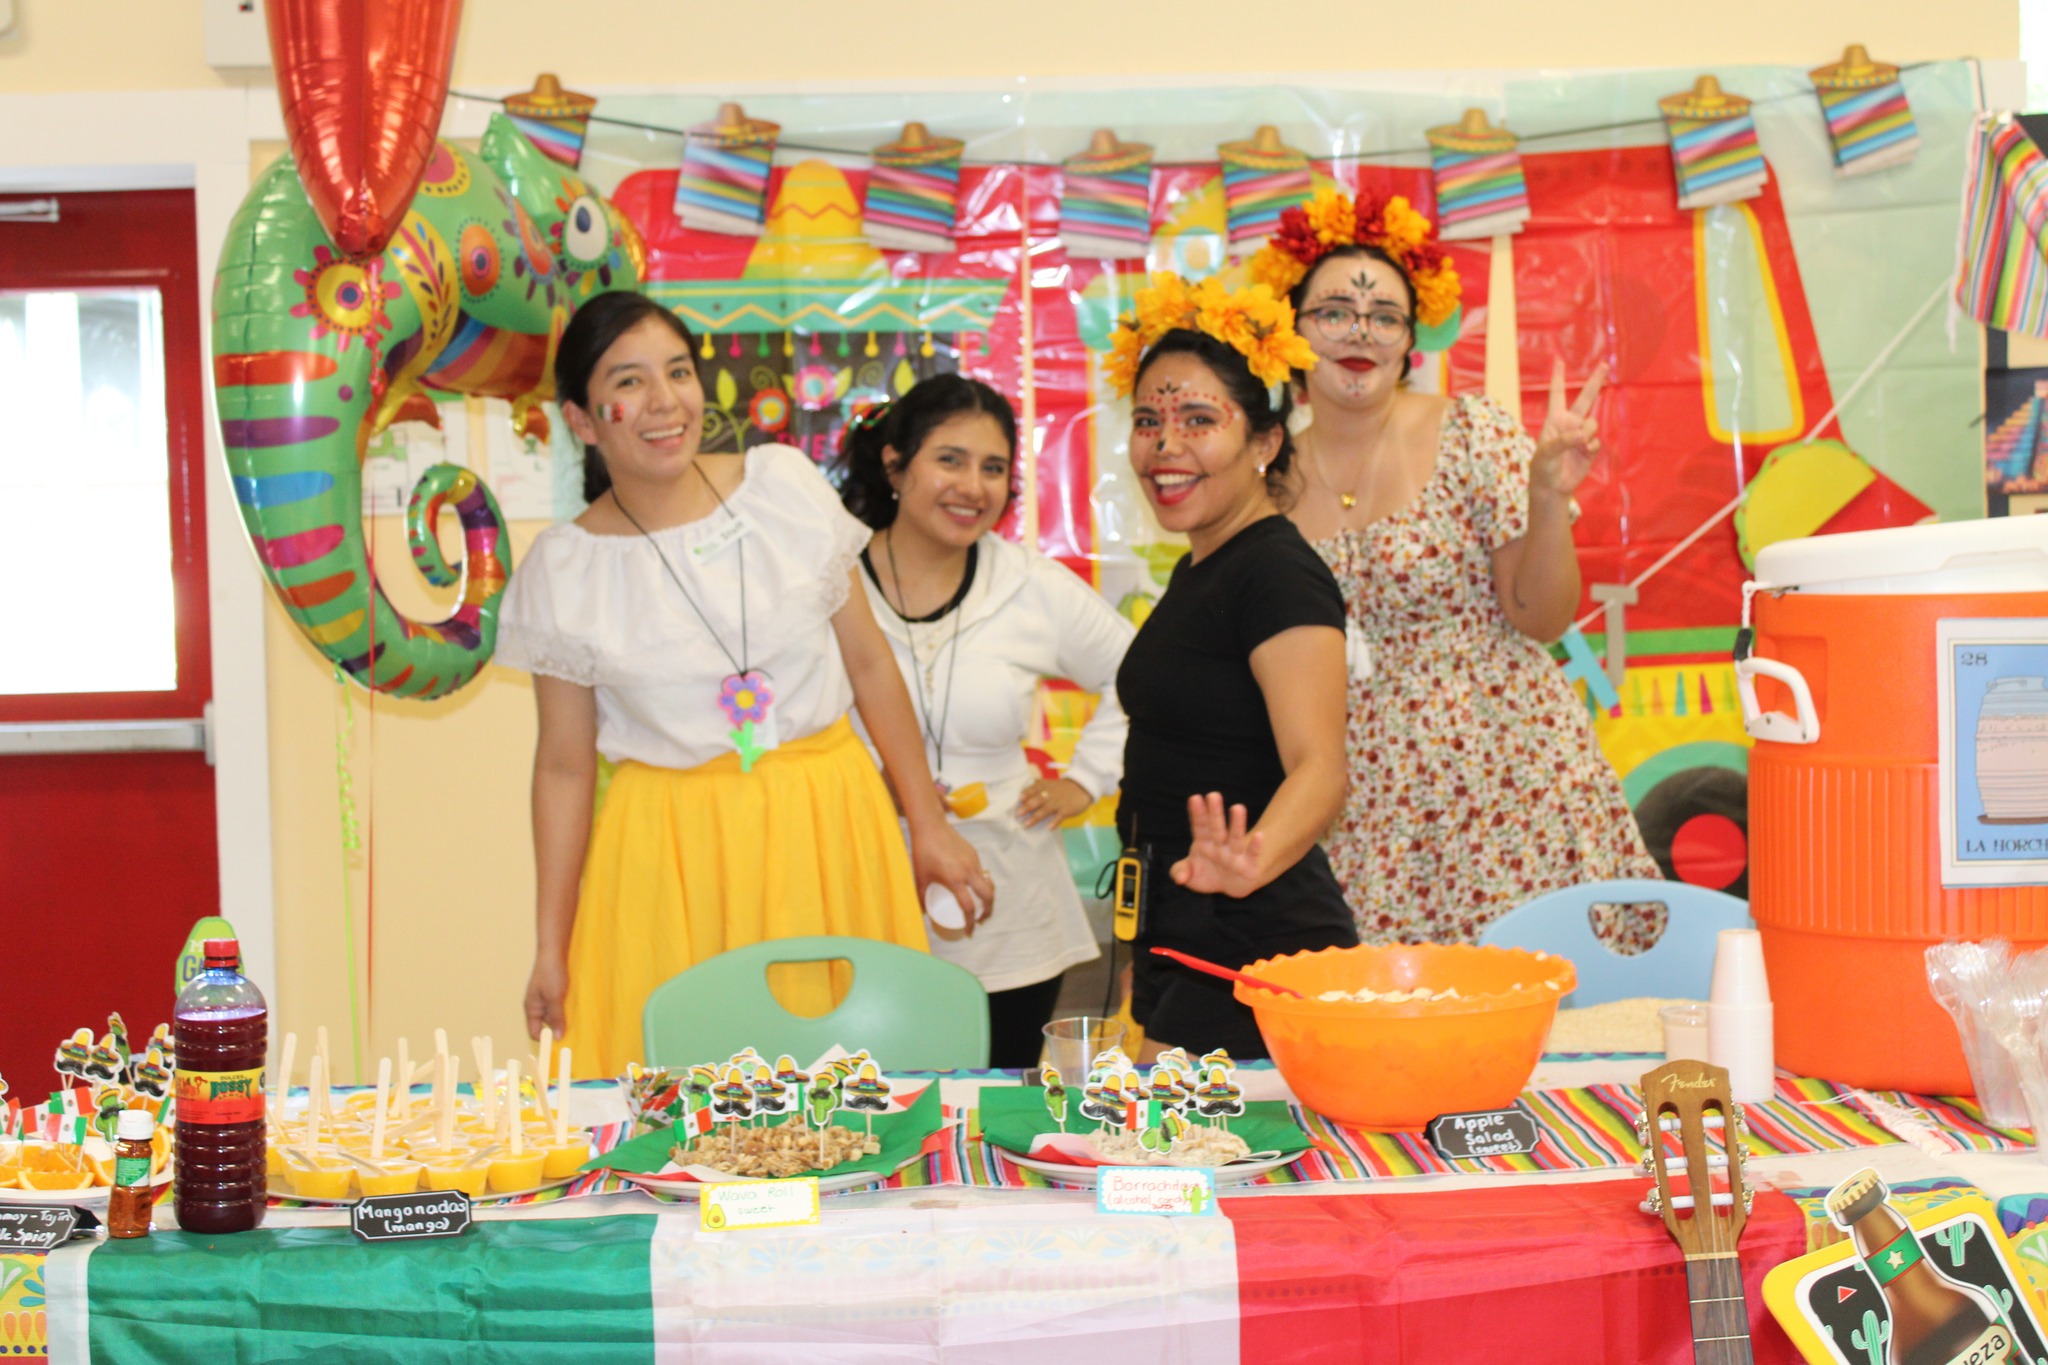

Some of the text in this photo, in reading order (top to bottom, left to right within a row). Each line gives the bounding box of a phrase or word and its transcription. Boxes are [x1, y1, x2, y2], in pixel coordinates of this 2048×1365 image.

[1960, 652, 1988, 666] 28
[1966, 840, 1986, 853] LA
[1661, 1072, 1716, 1093] Fender
[1454, 1115, 1505, 1133] Apple
[1464, 1128, 1514, 1145] Salad
[384, 1217, 450, 1233] (mango)
[13, 1228, 57, 1247] Spicy
